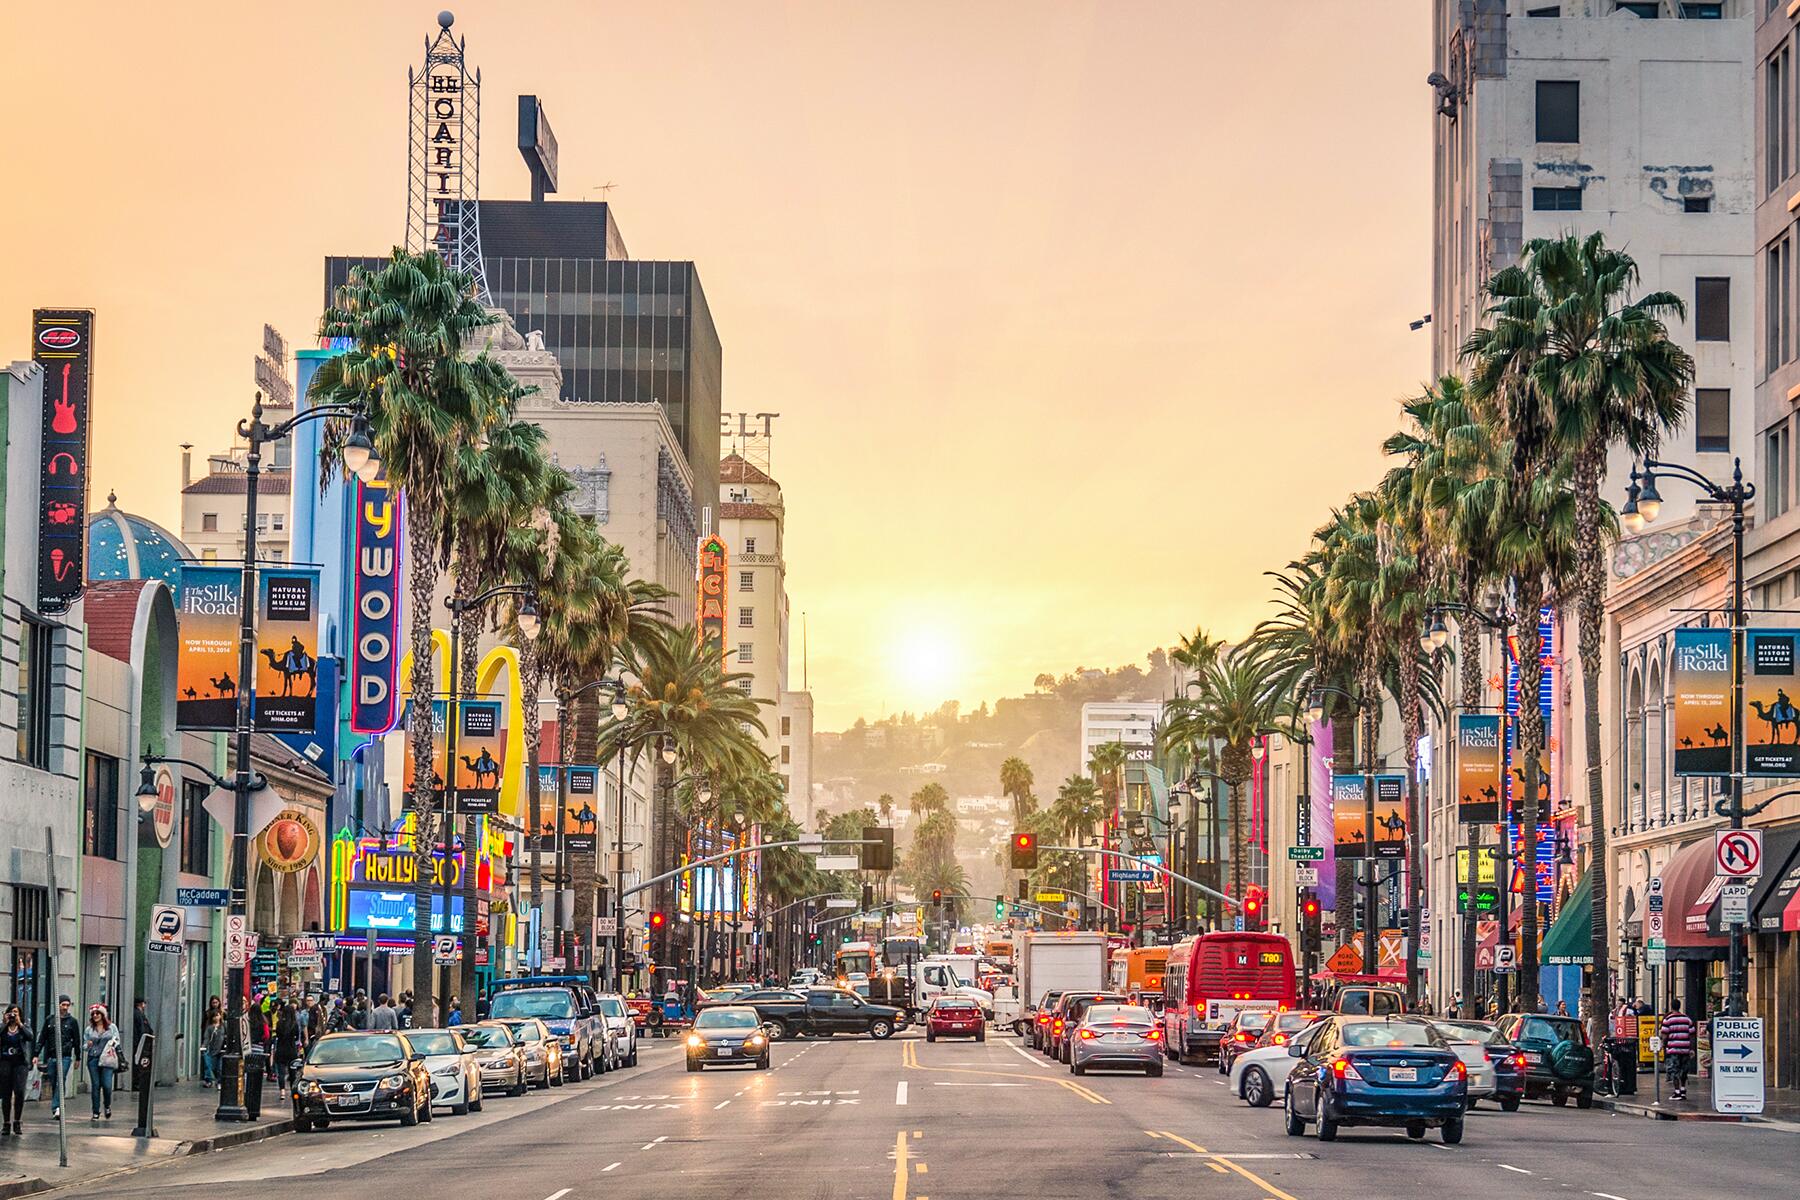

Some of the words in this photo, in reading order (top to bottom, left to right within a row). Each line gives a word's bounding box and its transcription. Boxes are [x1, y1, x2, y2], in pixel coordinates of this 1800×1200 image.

[703, 552, 724, 573] EL
[191, 586, 204, 596] The
[204, 585, 234, 602] Silk
[191, 597, 238, 615] Road
[1696, 644, 1722, 659] Silk
[1684, 654, 1728, 671] Road
[1475, 726, 1494, 738] Silk
[1466, 734, 1497, 747] Road
[1346, 784, 1362, 793] Silk
[1340, 790, 1364, 800] Road
[267, 858, 286, 871] Since
[289, 859, 307, 871] 1989
[365, 855, 460, 886] HOLLYO
[1112, 871, 1139, 879] Highland
[179, 889, 220, 899] McCadden
[1723, 887, 1746, 895] LAPD
[150, 943, 163, 951] PAY
[164, 945, 181, 953] HERE
[295, 940, 316, 950] ATM
[1263, 953, 1279, 963] 780
[1549, 956, 1571, 964] CAMERAS
[1716, 1022, 1760, 1030] PUBLIC
[1716, 1031, 1760, 1039] PARKING
